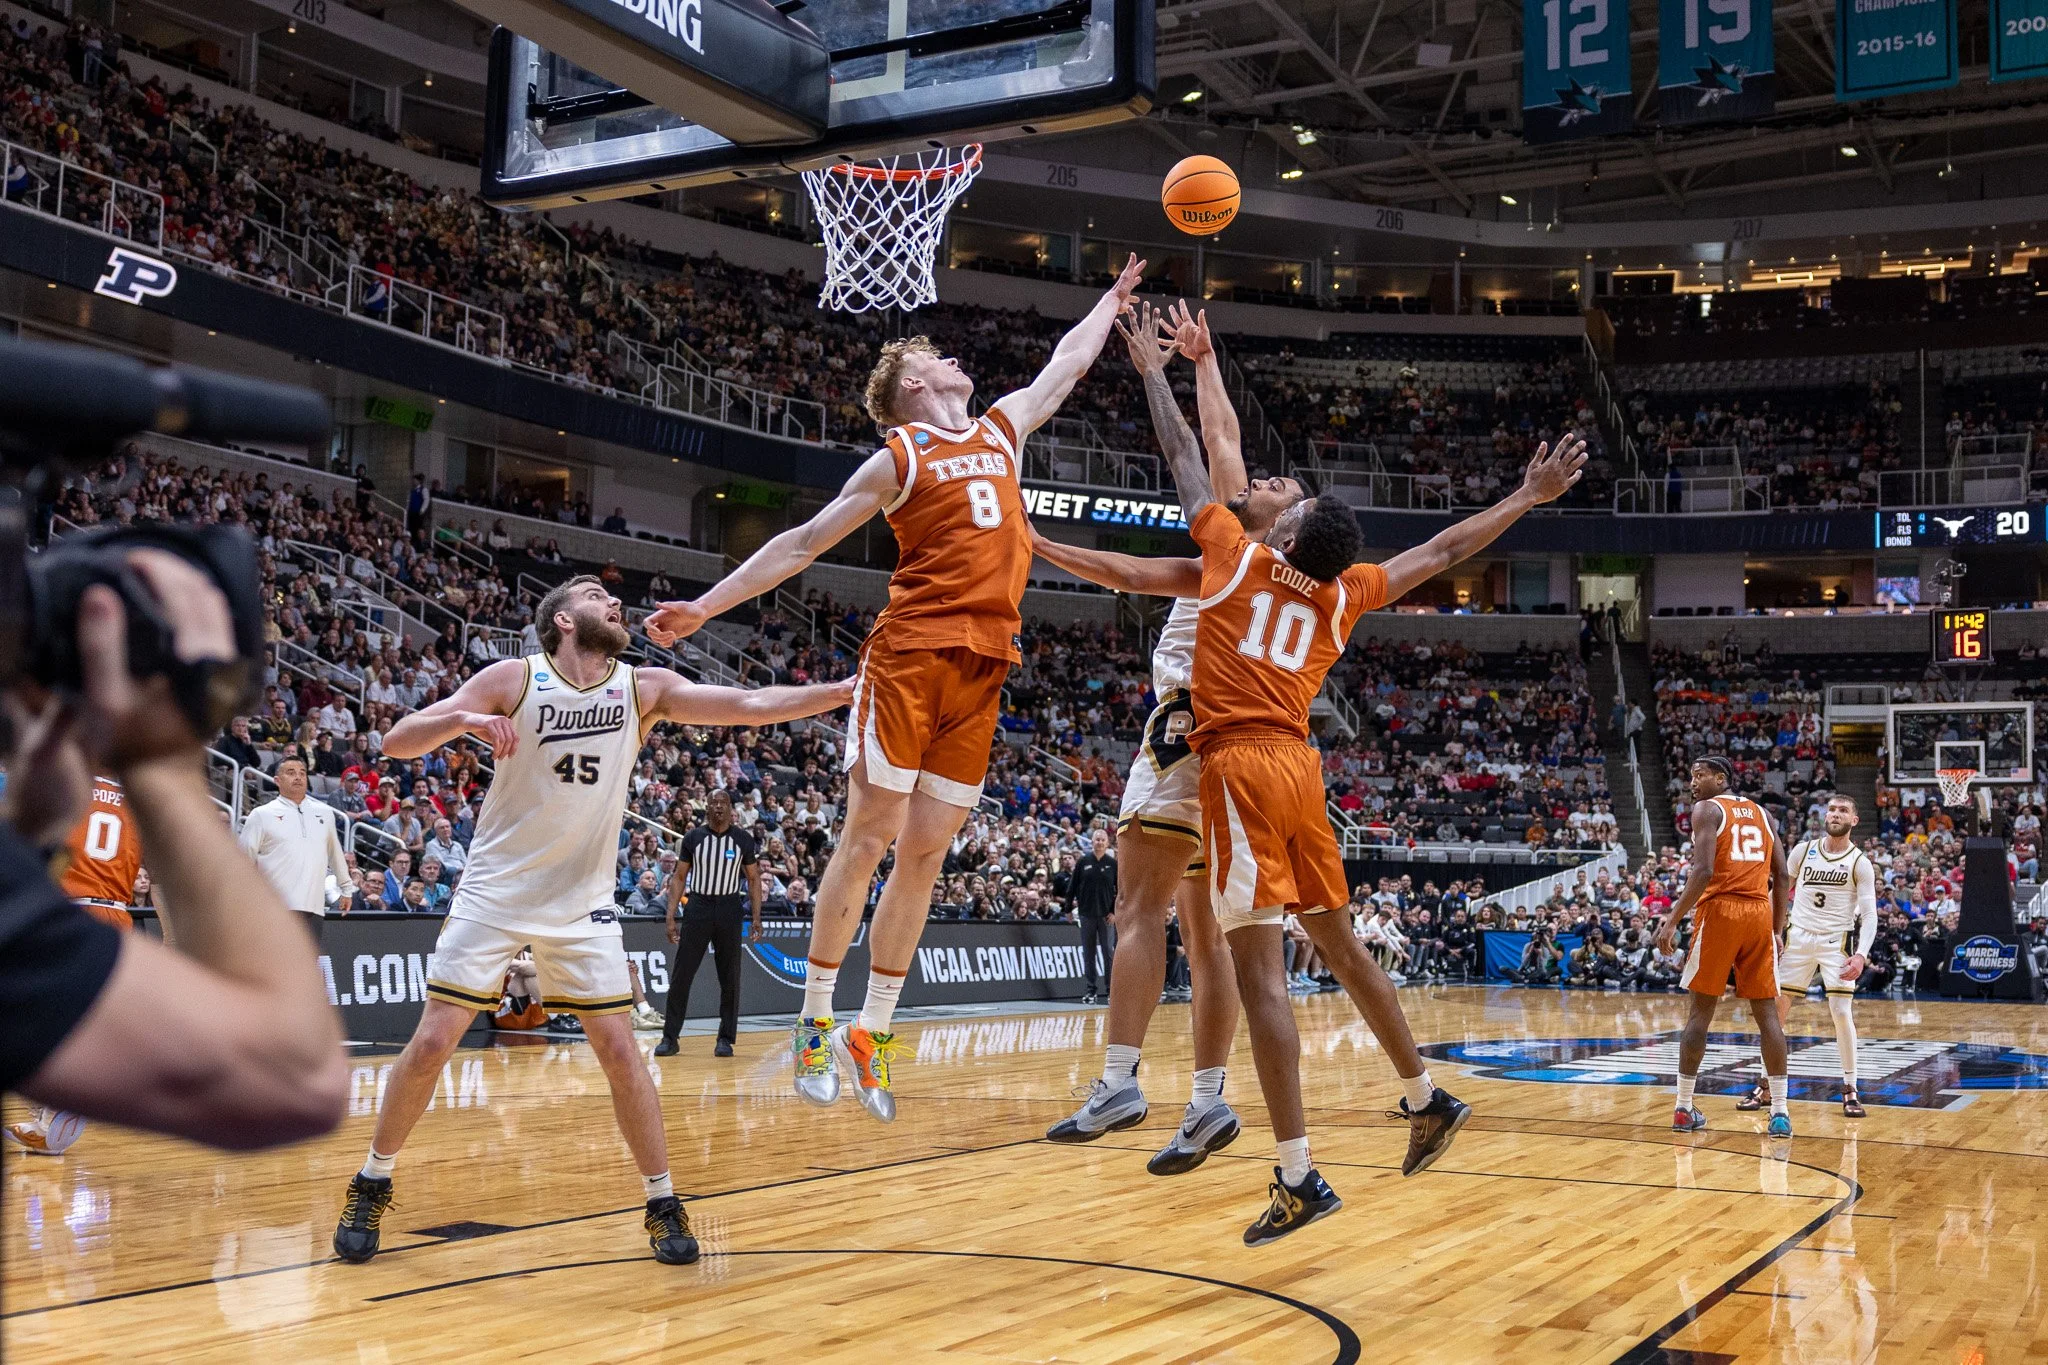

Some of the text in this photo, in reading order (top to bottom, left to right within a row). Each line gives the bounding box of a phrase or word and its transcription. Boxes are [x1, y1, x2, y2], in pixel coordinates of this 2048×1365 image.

[1543, 0, 1608, 70] 12
[2006, 15, 2048, 36] 200
[1857, 30, 1937, 56] 2015-16
[1048, 165, 1078, 187] 205
[1182, 207, 1233, 223] Wilson
[1376, 208, 1404, 231] 206
[1733, 218, 1763, 240] 207
[94, 247, 177, 305] P
[926, 452, 1008, 482] TEXAS
[966, 480, 1002, 528] 8
[1896, 512, 1911, 523] TOL
[1996, 511, 2030, 535] 20
[1885, 536, 1912, 547] BONUS
[1897, 525, 1926, 535] FLS 2
[1271, 563, 1320, 598] CODIE
[1238, 591, 1319, 673] 10
[1944, 612, 1985, 630] 11:42
[1955, 629, 1981, 658] 16
[536, 702, 625, 743] Purdue
[552, 752, 601, 786] 45
[92, 788, 124, 806] POPE
[84, 810, 122, 861] 0
[1730, 823, 1765, 862] 12
[1803, 866, 1849, 886] Purdue
[1814, 892, 1826, 908] 3
[1966, 947, 2000, 958] MARCH
[1969, 956, 2016, 968] MADNESS
